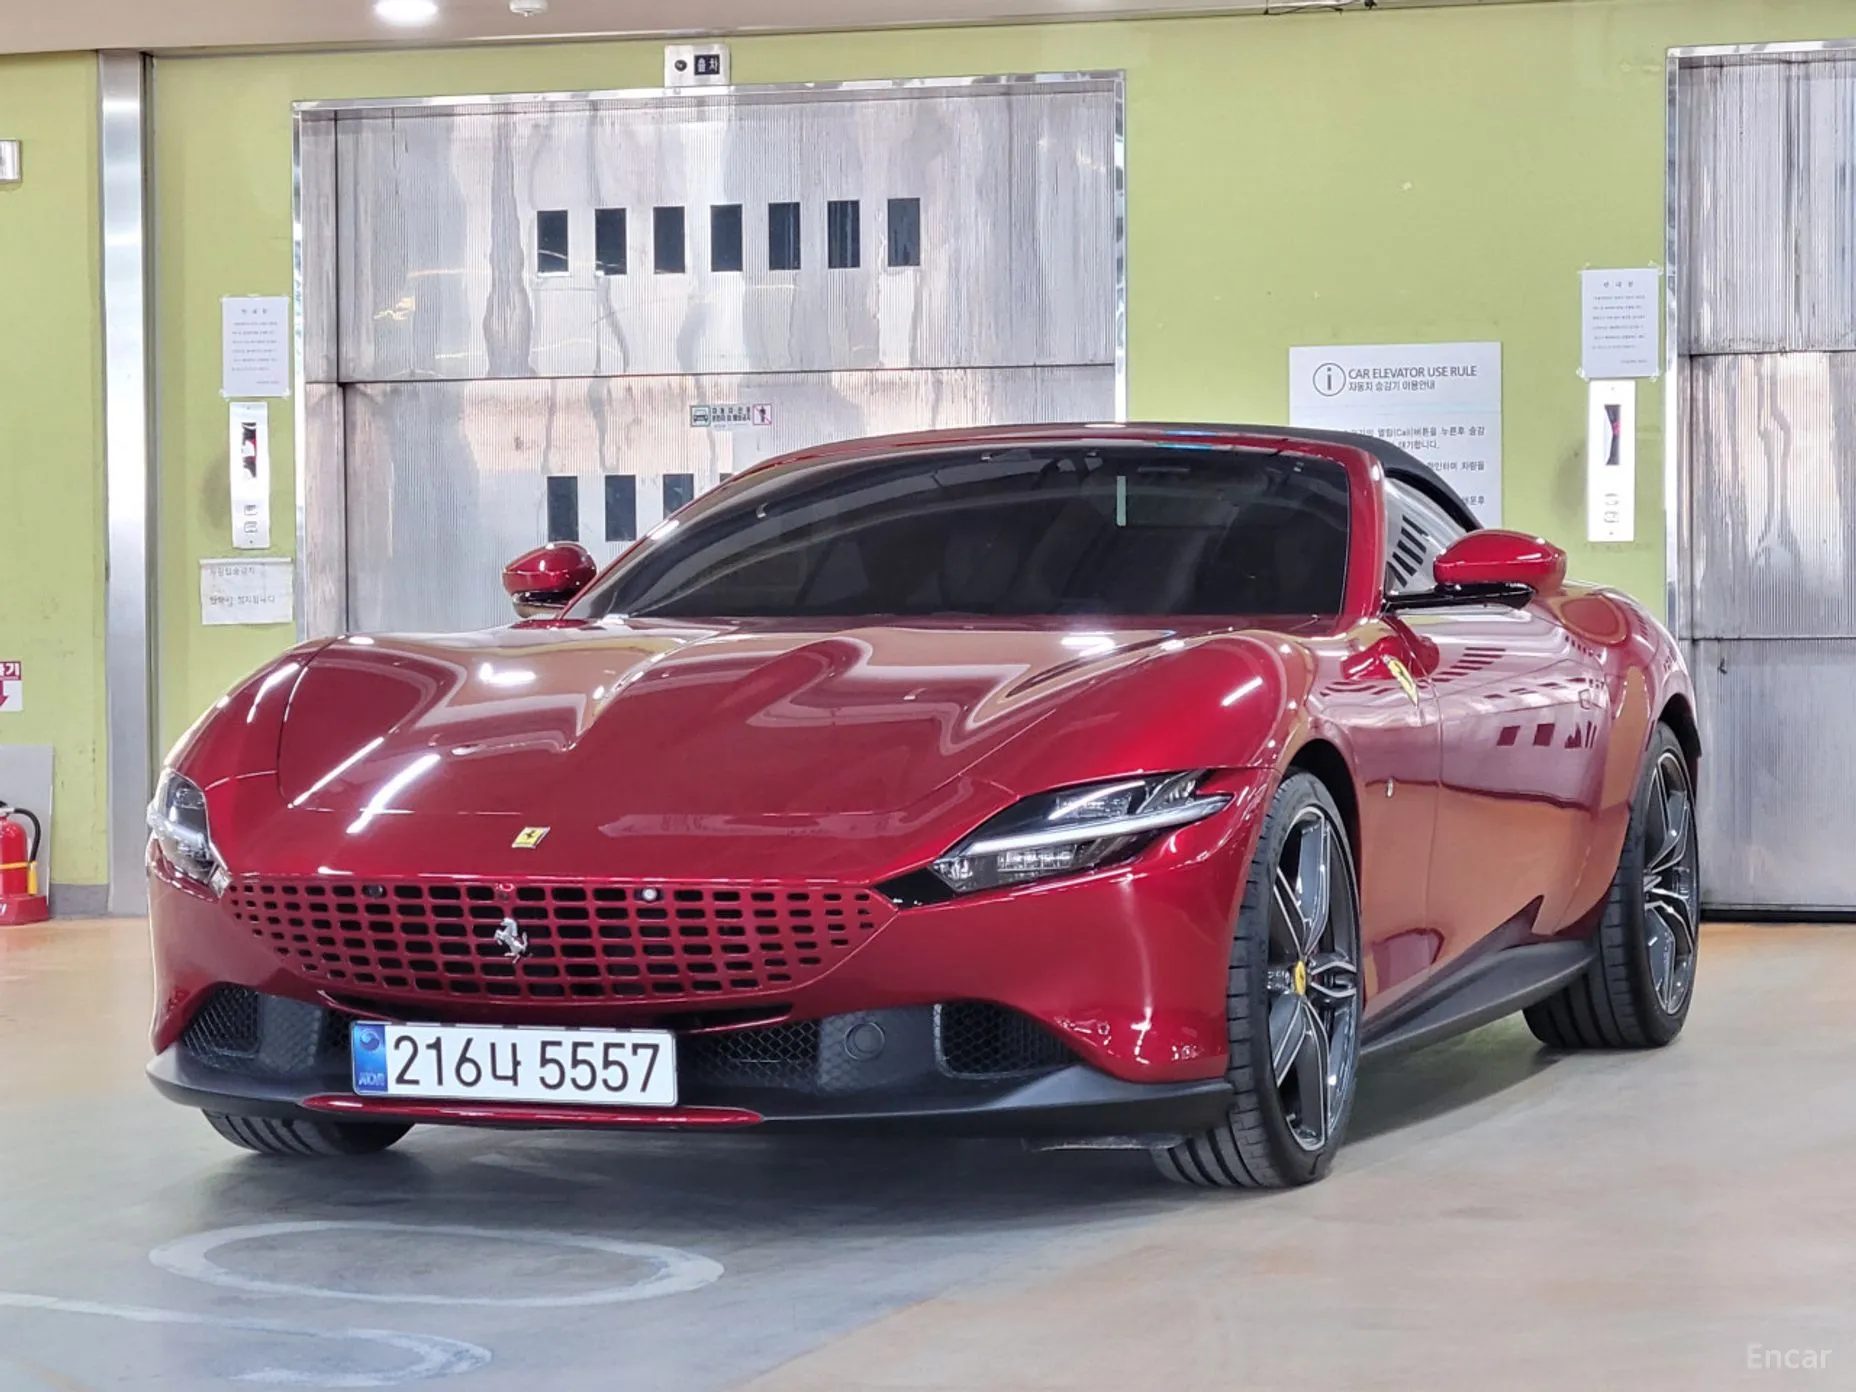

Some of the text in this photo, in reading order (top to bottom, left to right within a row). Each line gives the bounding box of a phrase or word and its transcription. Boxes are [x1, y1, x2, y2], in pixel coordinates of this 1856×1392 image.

[697, 57, 718, 72] 출차
[1348, 365, 1478, 379] CAR ELEVATOR USE RULE
[1348, 380, 1436, 392] 자동차 승강기 이용안내
[393, 1035, 660, 1093] 216나 5557
